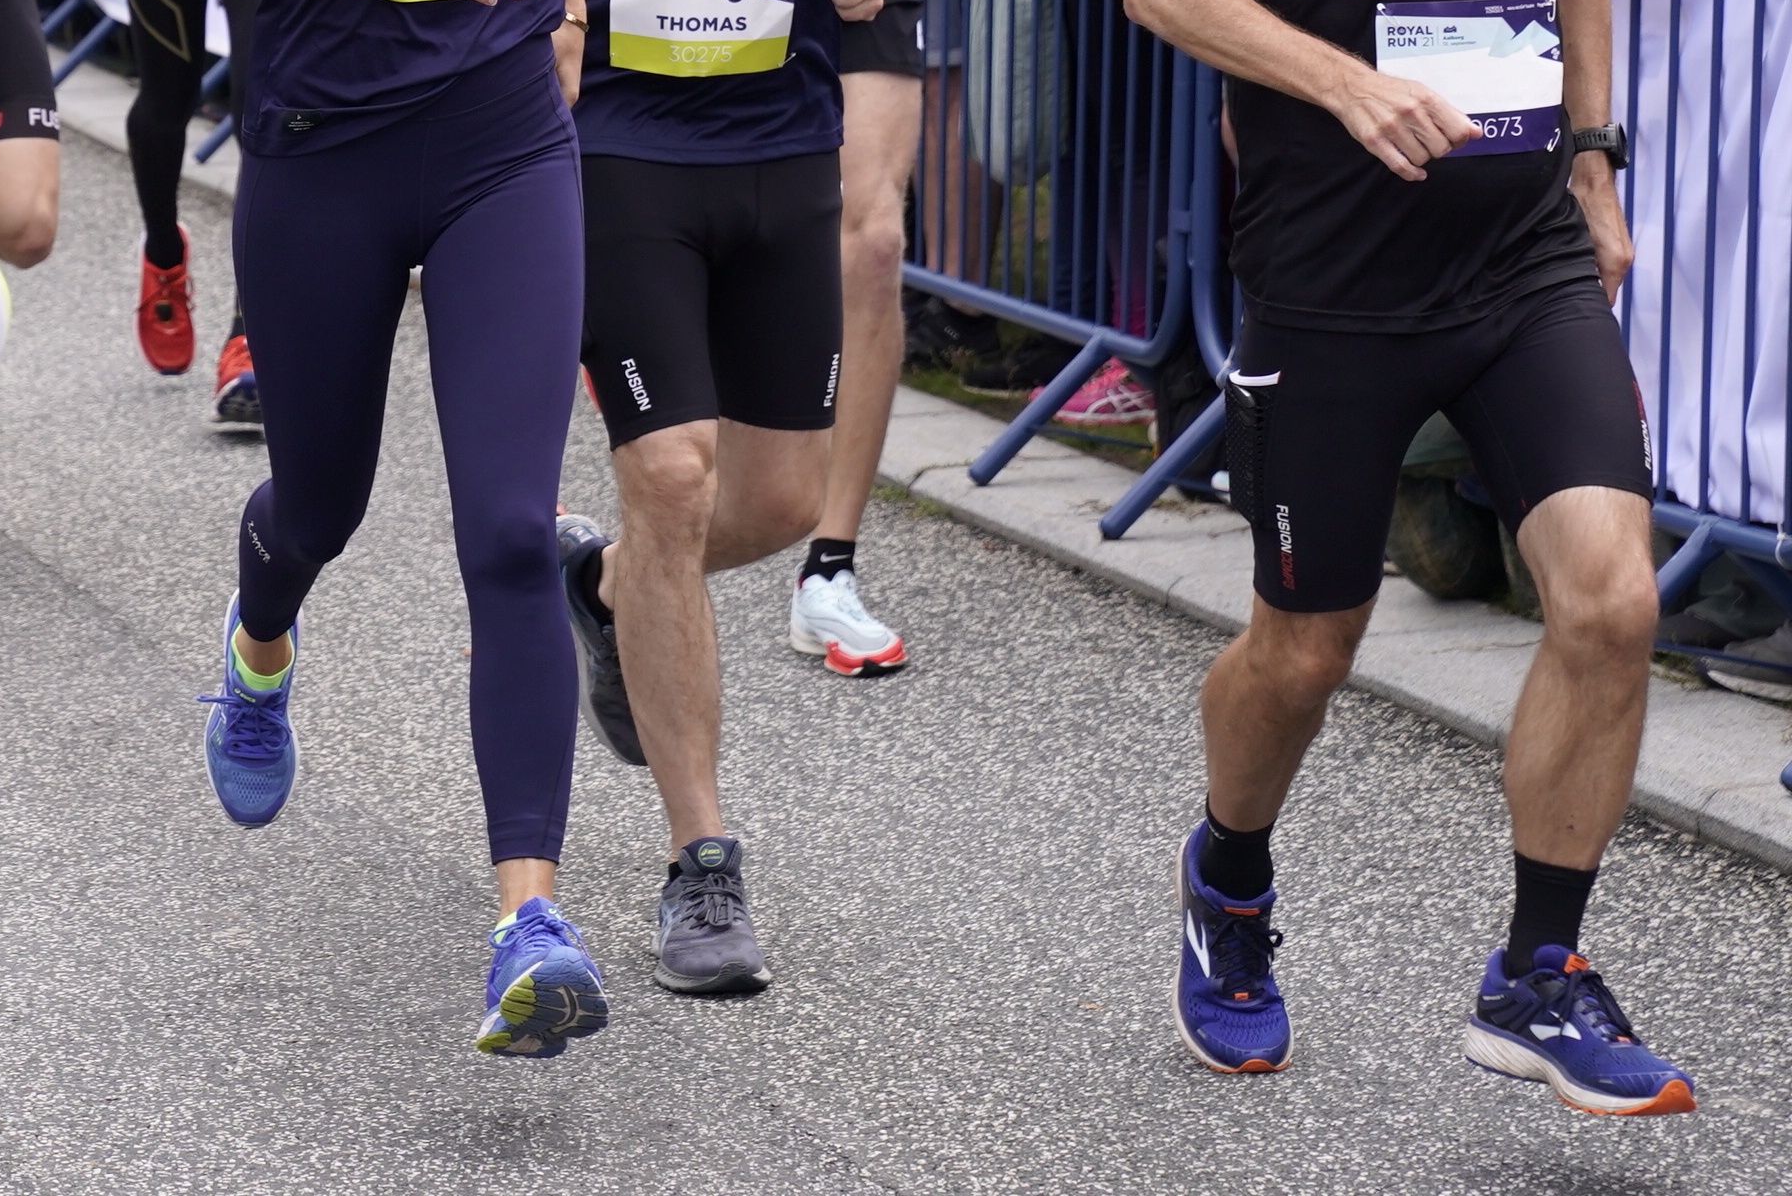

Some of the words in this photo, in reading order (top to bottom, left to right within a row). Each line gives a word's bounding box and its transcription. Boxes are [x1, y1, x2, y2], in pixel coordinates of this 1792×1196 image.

[656, 15, 747, 32] THOMAS
[1387, 26, 1433, 36] ROYAL
[1388, 37, 1417, 47] RUN
[669, 45, 733, 63] 30275
[621, 358, 652, 411] FUSION
[823, 353, 840, 407] FUSION
[1276, 504, 1293, 554] FUSION
